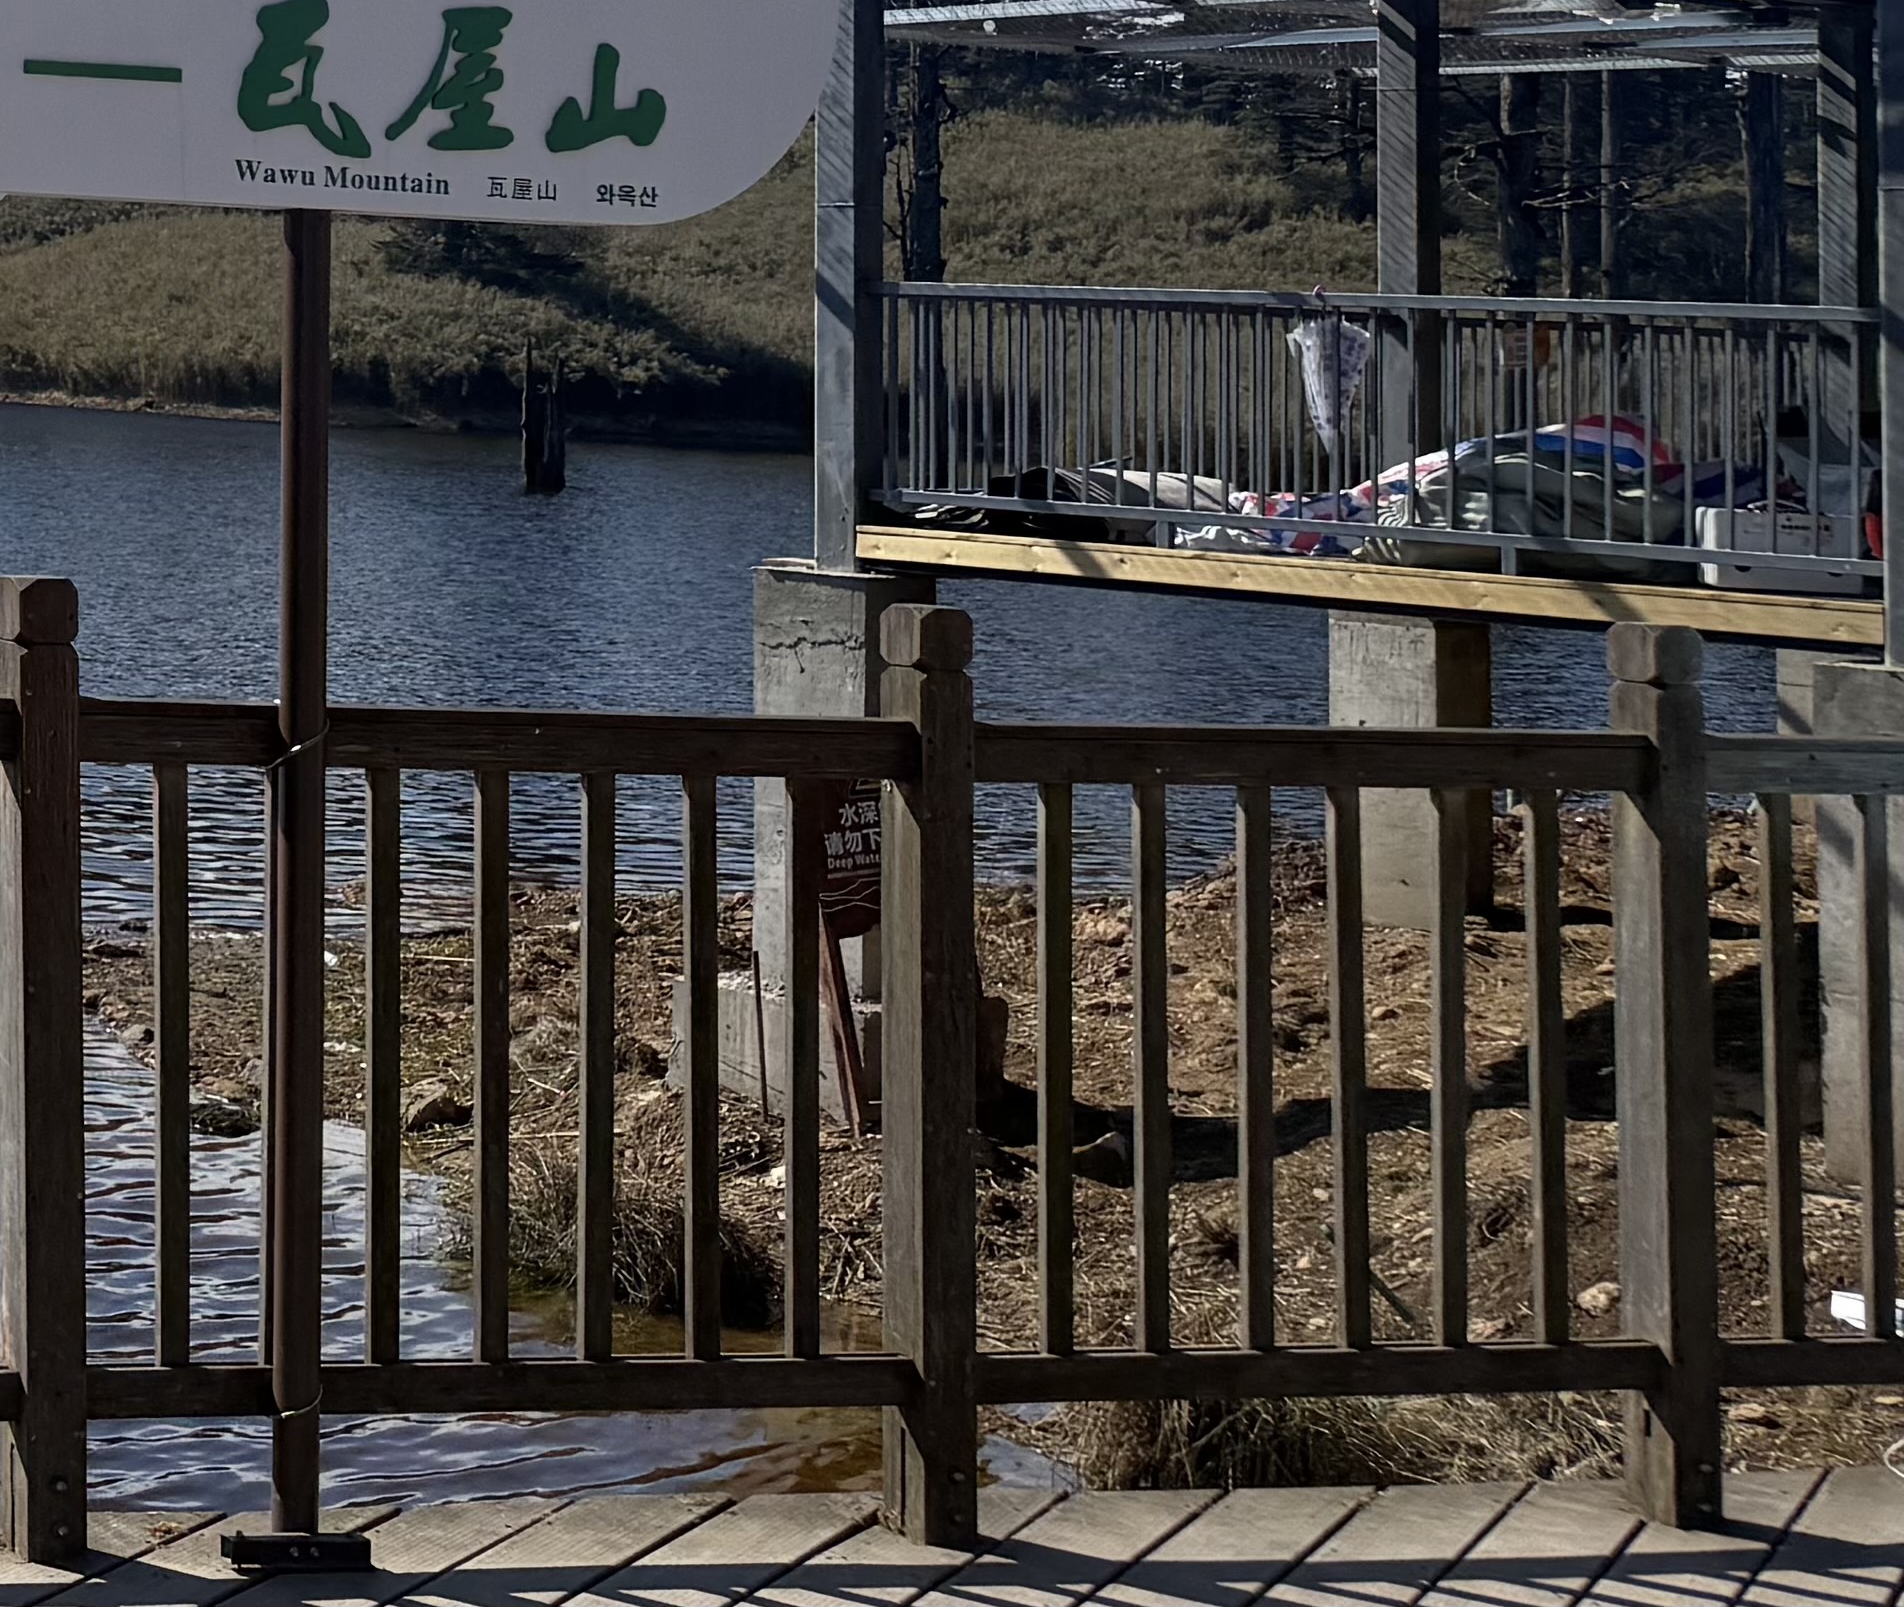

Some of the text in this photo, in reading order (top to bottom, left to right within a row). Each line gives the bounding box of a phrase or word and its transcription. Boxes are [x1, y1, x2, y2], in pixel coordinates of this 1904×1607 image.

[234, 158, 451, 196] Wawu Mountain
[486, 175, 558, 202] 瓦屋山
[838, 801, 881, 827] 水深
[827, 857, 854, 870] Deep
